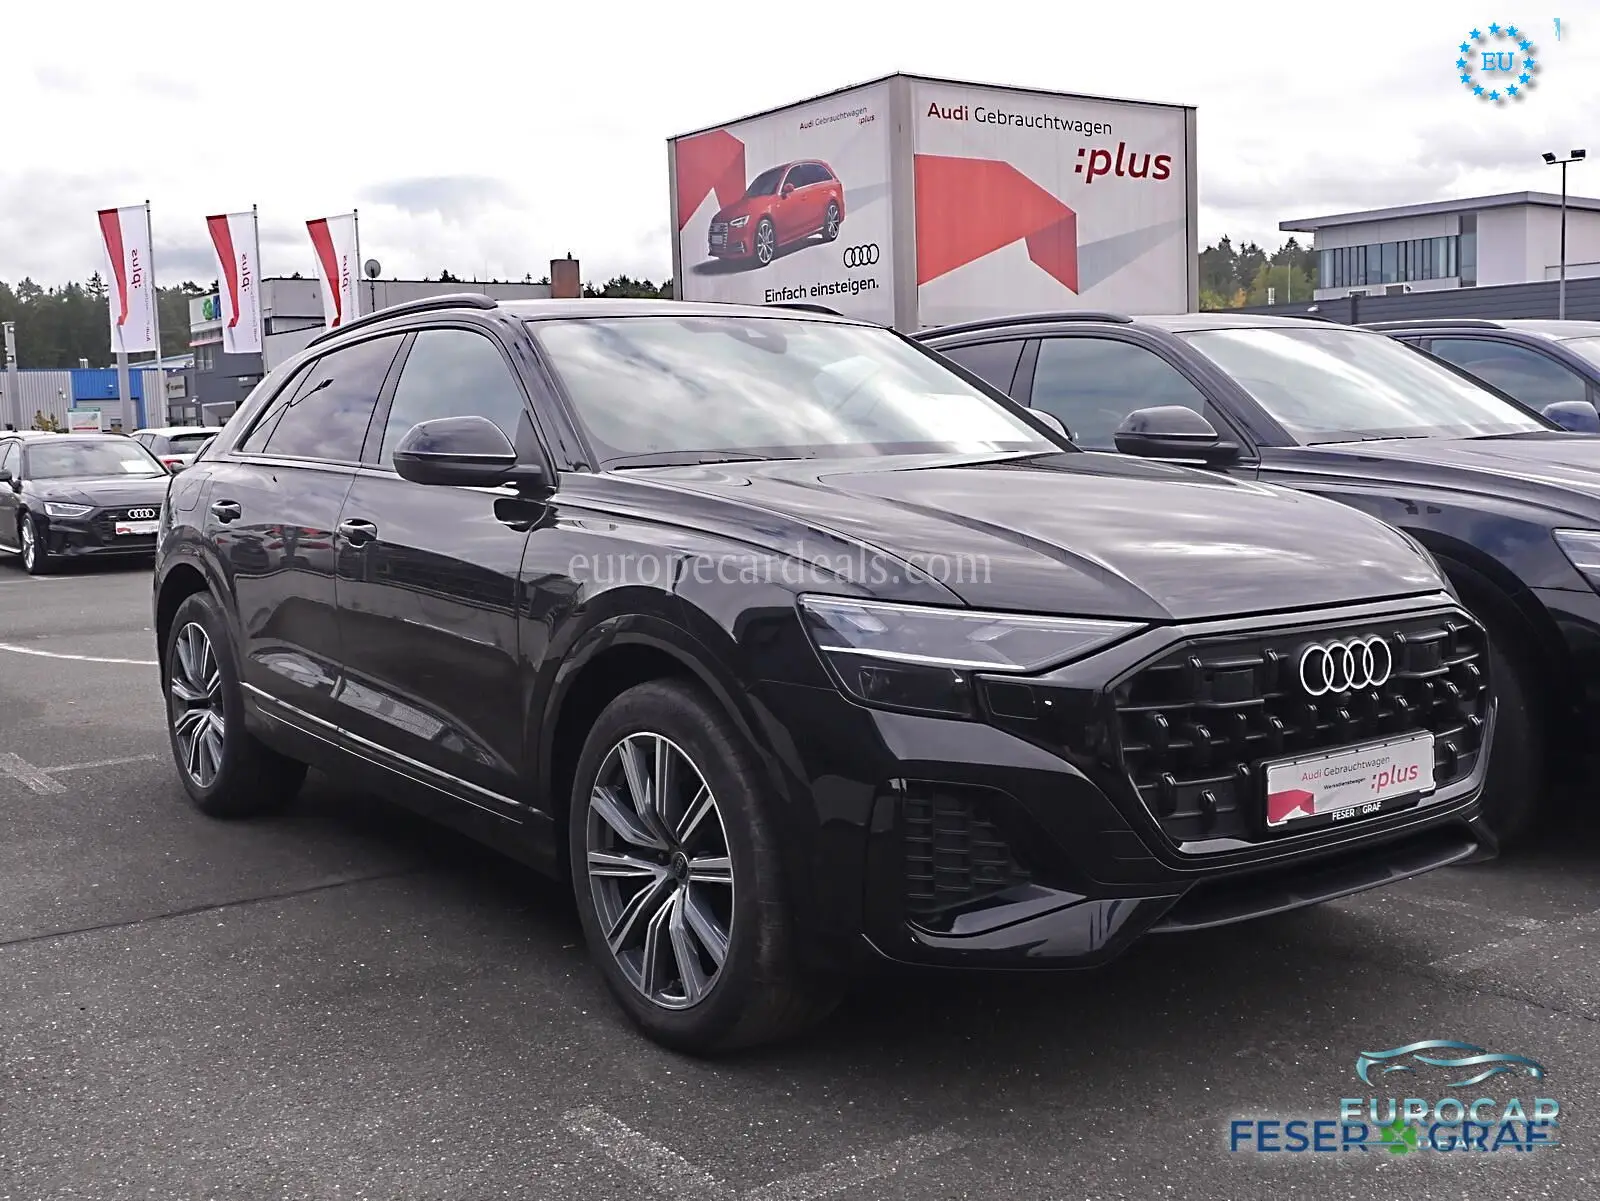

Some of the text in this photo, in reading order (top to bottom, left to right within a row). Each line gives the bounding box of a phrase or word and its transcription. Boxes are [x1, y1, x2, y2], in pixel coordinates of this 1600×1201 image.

[800, 106, 868, 130] Audi Gebrauchtwagen
[927, 102, 1112, 137] Audi Gebrauchtwagen
[1074, 141, 1172, 184] :plus
[765, 277, 879, 303] Einfach einsteigen.
[1302, 756, 1390, 781] Audi Gebrauchtwagen
[1371, 764, 1418, 793] :plus
[1332, 802, 1382, 821] FESER GRAF
